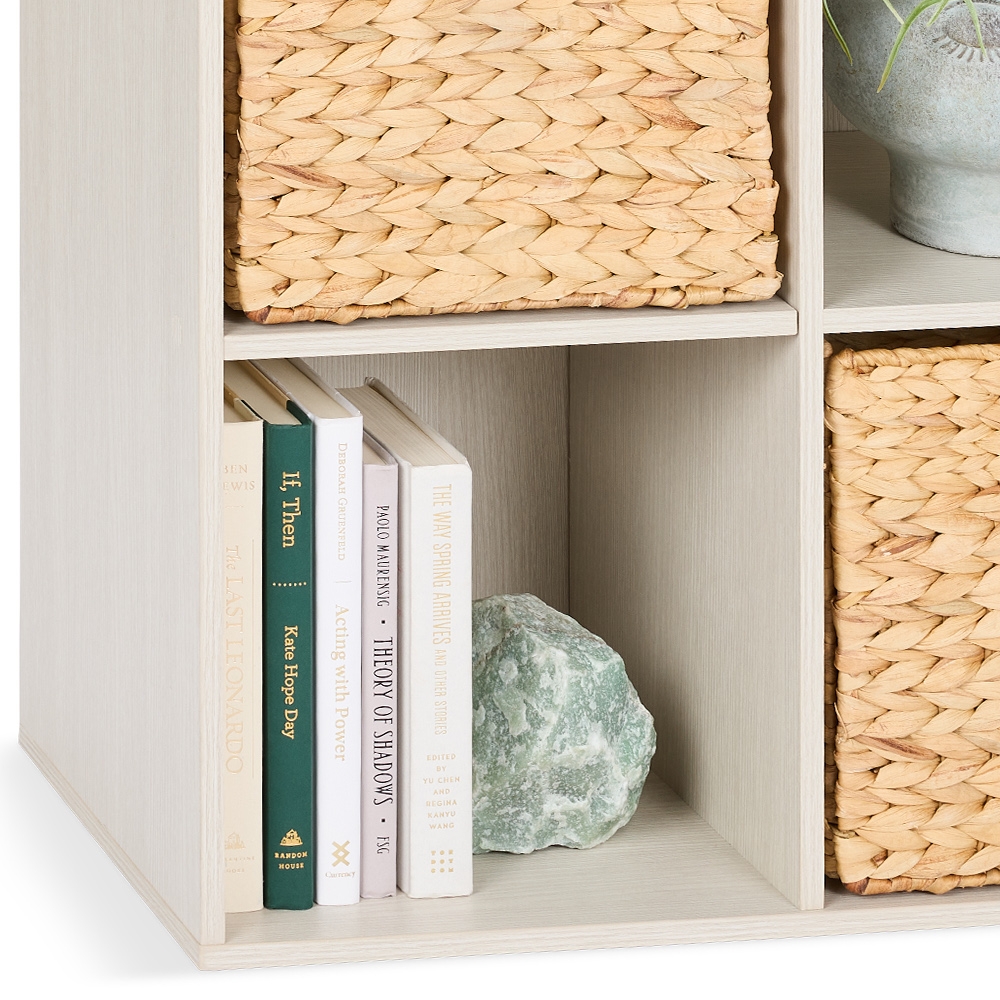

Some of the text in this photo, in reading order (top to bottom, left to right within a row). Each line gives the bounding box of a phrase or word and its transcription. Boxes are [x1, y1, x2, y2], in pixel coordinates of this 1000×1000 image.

[222, 481, 255, 491] EWIS
[338, 443, 348, 561] DEBORAH GRUENFELD
[279, 471, 302, 548] If, Then
[432, 483, 452, 735] THE WAY SPRING ARRIVES AND OTHER STORIES
[225, 545, 244, 774] The LAST LEONARDO
[281, 625, 299, 740] Kate Hope Day
[331, 604, 350, 761] Acting with Power
[373, 505, 394, 855] PAOLO MAURENSIG THEORY OF SHADOWS FSG
[426, 753, 456, 761] EDITED
[423, 776, 460, 785] YU CHEN
[433, 788, 451, 796] AND
[425, 799, 458, 807] REGINA
[427, 810, 456, 819] KANYU
[429, 822, 455, 830] WANG
[274, 851, 308, 860] RANDOM
[278, 862, 305, 870] HOUSE
